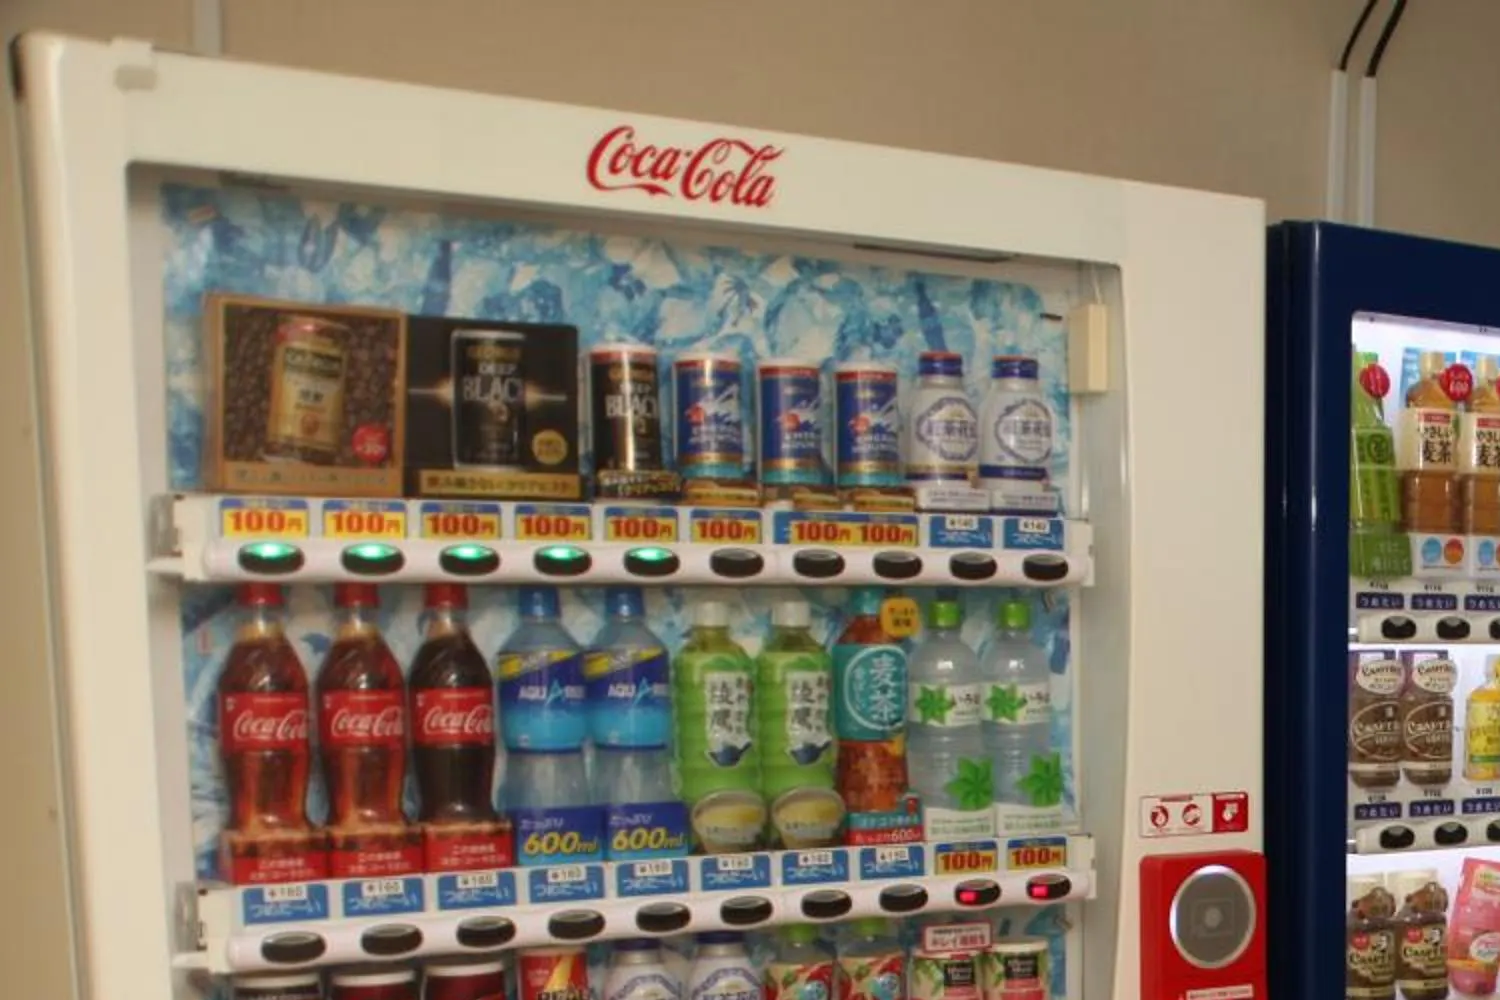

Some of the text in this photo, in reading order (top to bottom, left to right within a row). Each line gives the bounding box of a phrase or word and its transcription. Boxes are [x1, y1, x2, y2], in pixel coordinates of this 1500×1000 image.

[586, 125, 785, 208] Coca-Cola
[1423, 440, 1452, 463] 麦茶
[869, 653, 897, 722] 麦茶
[1358, 806, 1398, 818] つめたい
[1413, 803, 1451, 815] つめたい
[523, 831, 600, 854] 600ml
[612, 826, 687, 850] 600ml
